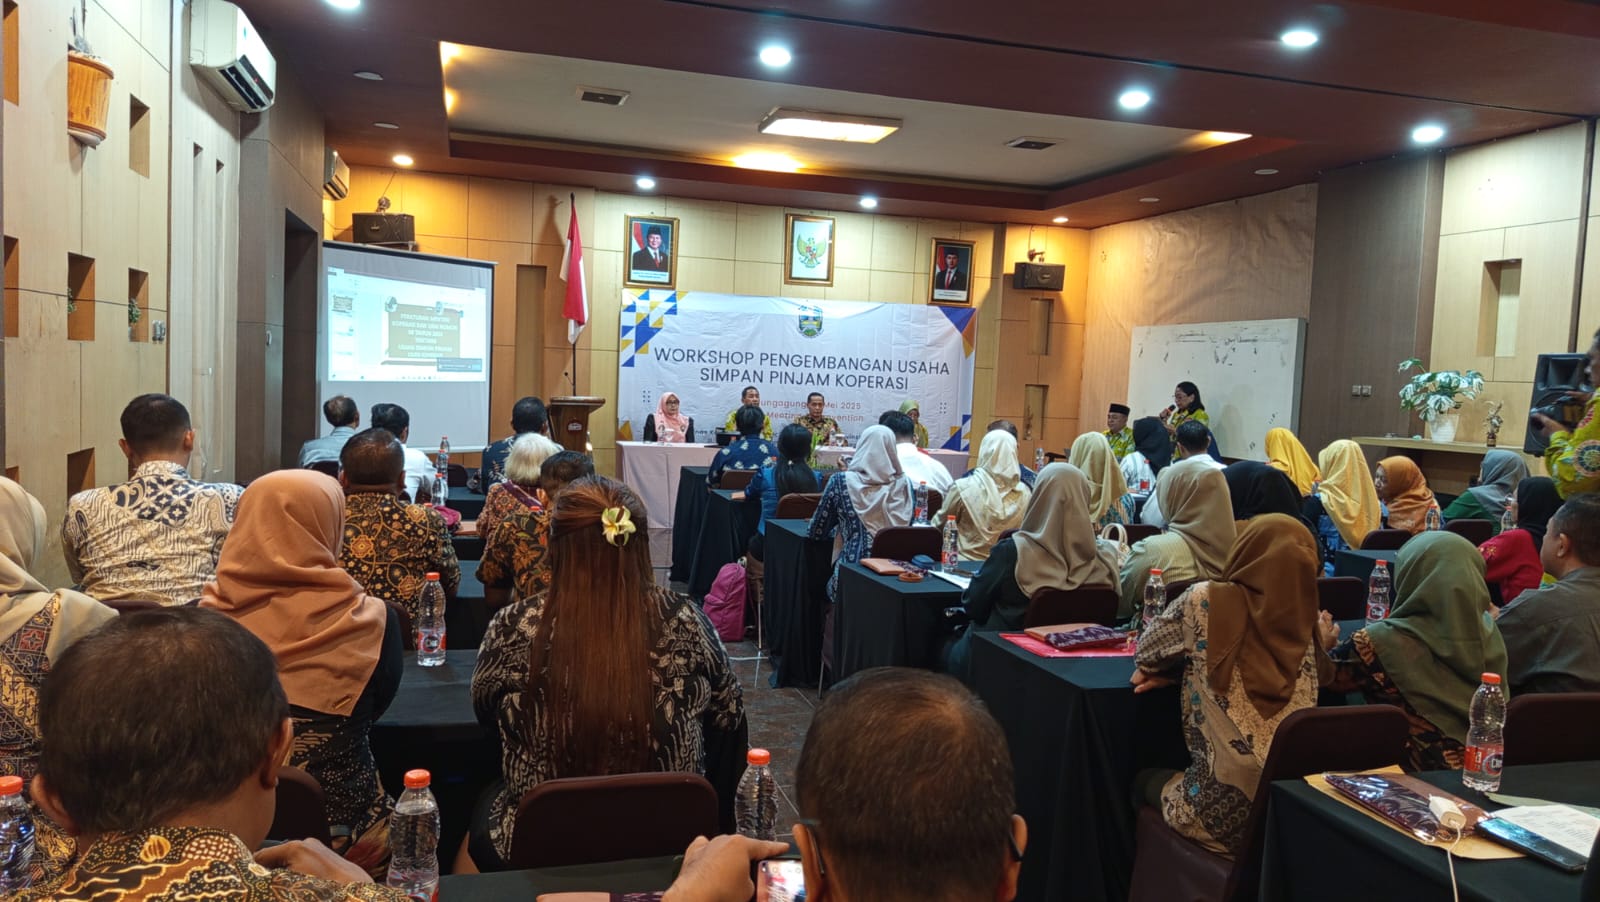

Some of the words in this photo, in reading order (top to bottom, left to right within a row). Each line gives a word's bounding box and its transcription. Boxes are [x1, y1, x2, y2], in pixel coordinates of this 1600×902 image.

[654, 347, 754, 365] WORKSHOP
[759, 352, 893, 372] PENGEMBANGAN
[897, 360, 950, 375] USAHA
[700, 367, 764, 383] SIMPAN
[769, 370, 830, 386] PINJAM
[835, 374, 908, 390] KOPERASI
[760, 400, 807, 409] ungagung
[840, 401, 862, 410] 2025
